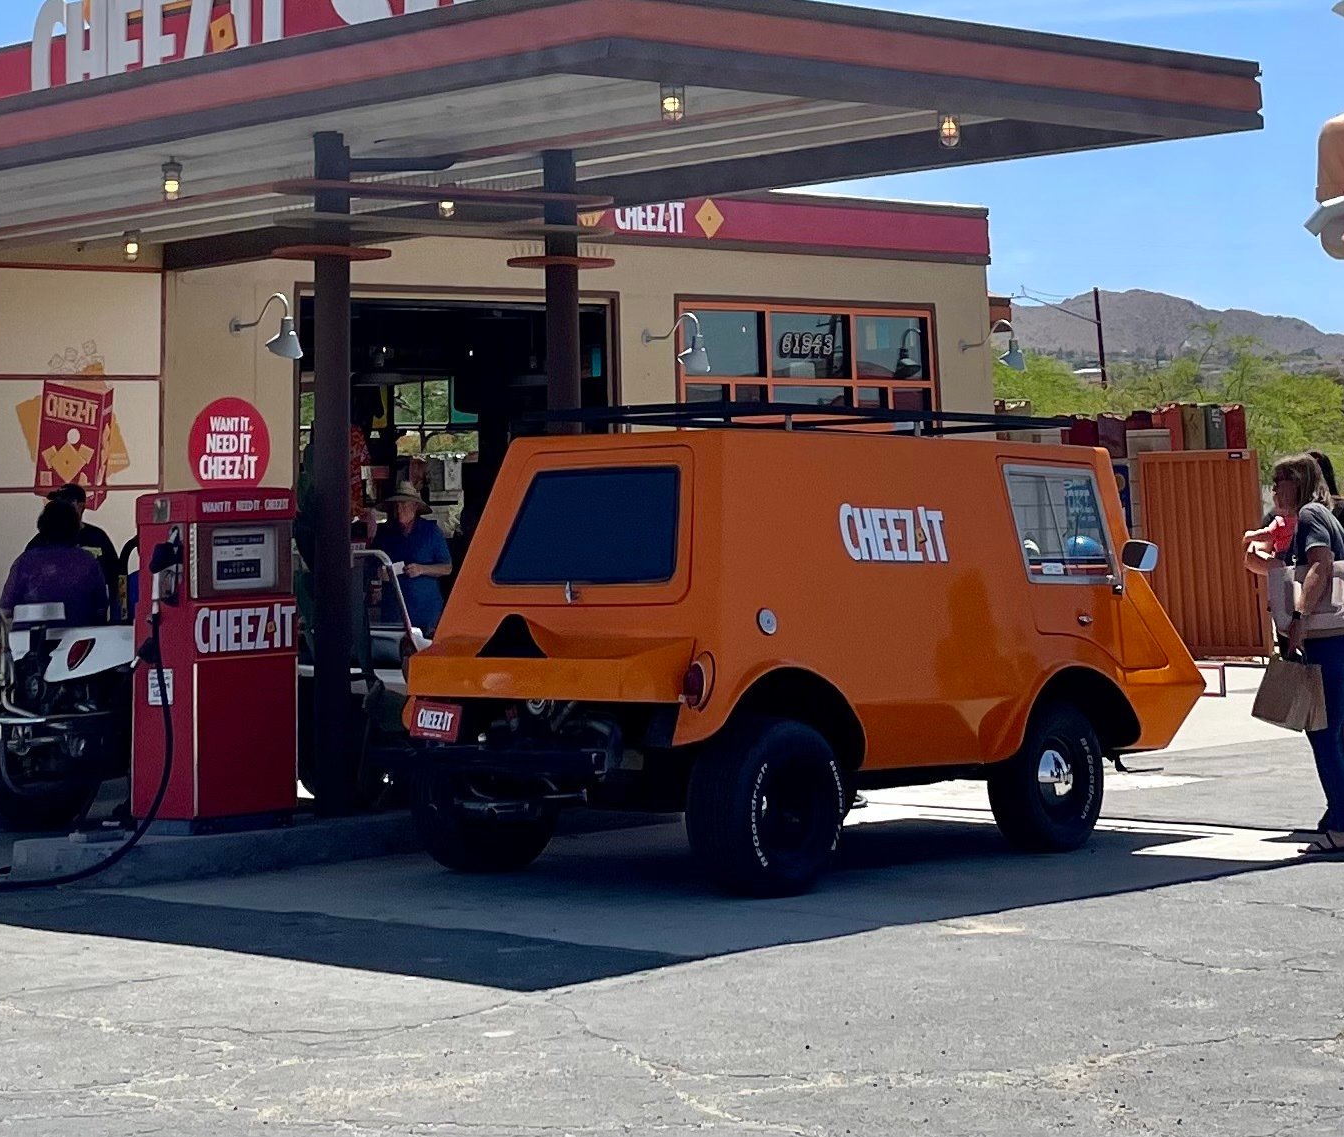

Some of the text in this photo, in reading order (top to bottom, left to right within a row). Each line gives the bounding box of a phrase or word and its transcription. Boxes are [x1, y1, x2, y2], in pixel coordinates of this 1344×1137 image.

[209, 415, 239, 432] WANT
[205, 432, 239, 454] NEED
[201, 501, 224, 513] WANT
